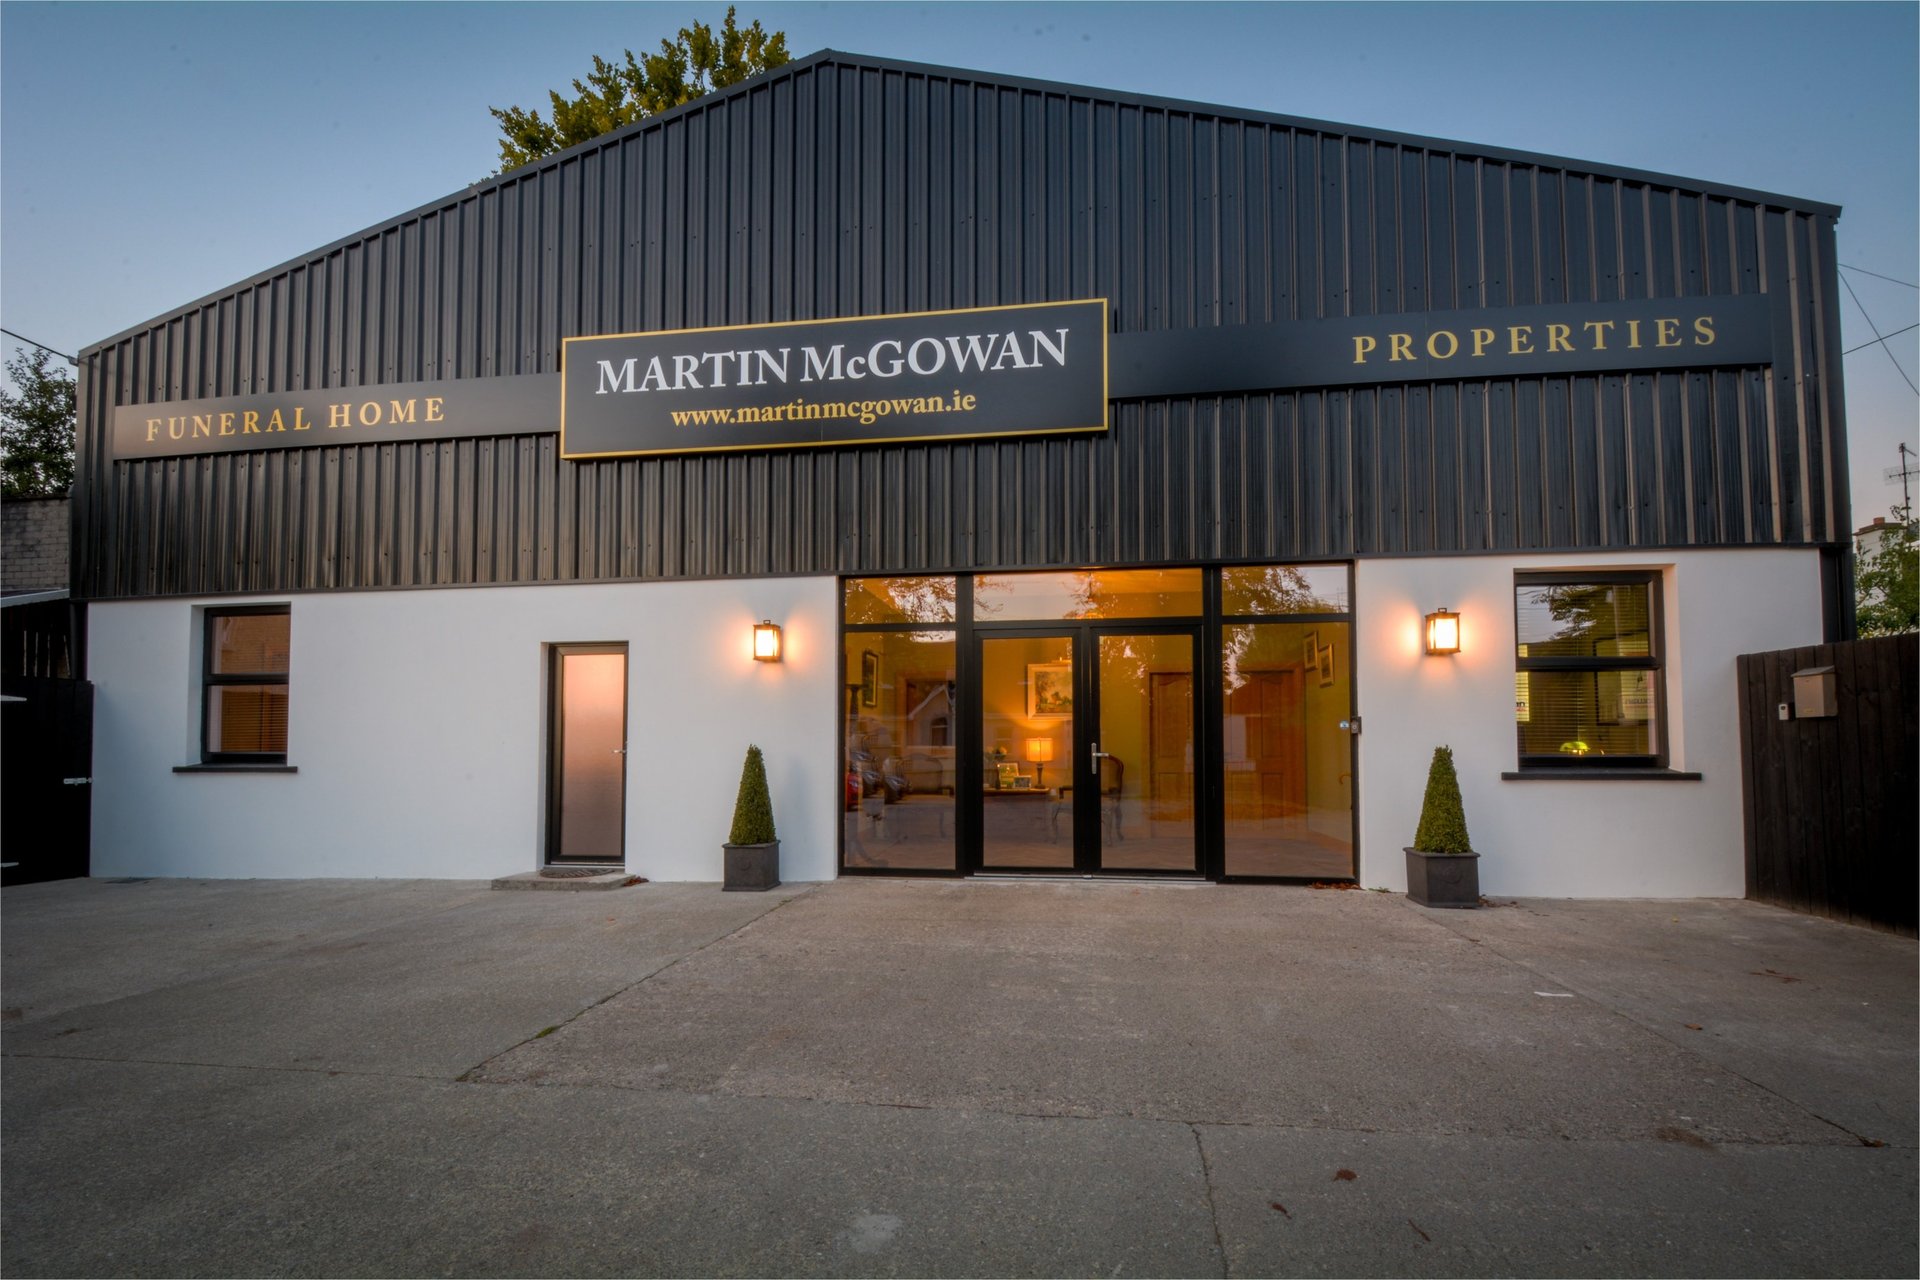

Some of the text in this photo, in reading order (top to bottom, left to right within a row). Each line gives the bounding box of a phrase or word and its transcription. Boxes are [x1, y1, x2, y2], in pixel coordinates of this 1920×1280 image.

[595, 328, 1070, 396] MARTIN McGOWAN
[1352, 315, 1717, 364] PROPERTIES
[145, 397, 445, 442] FUNERAL HOME
[671, 389, 977, 427] www.martinmcgowan.ie
